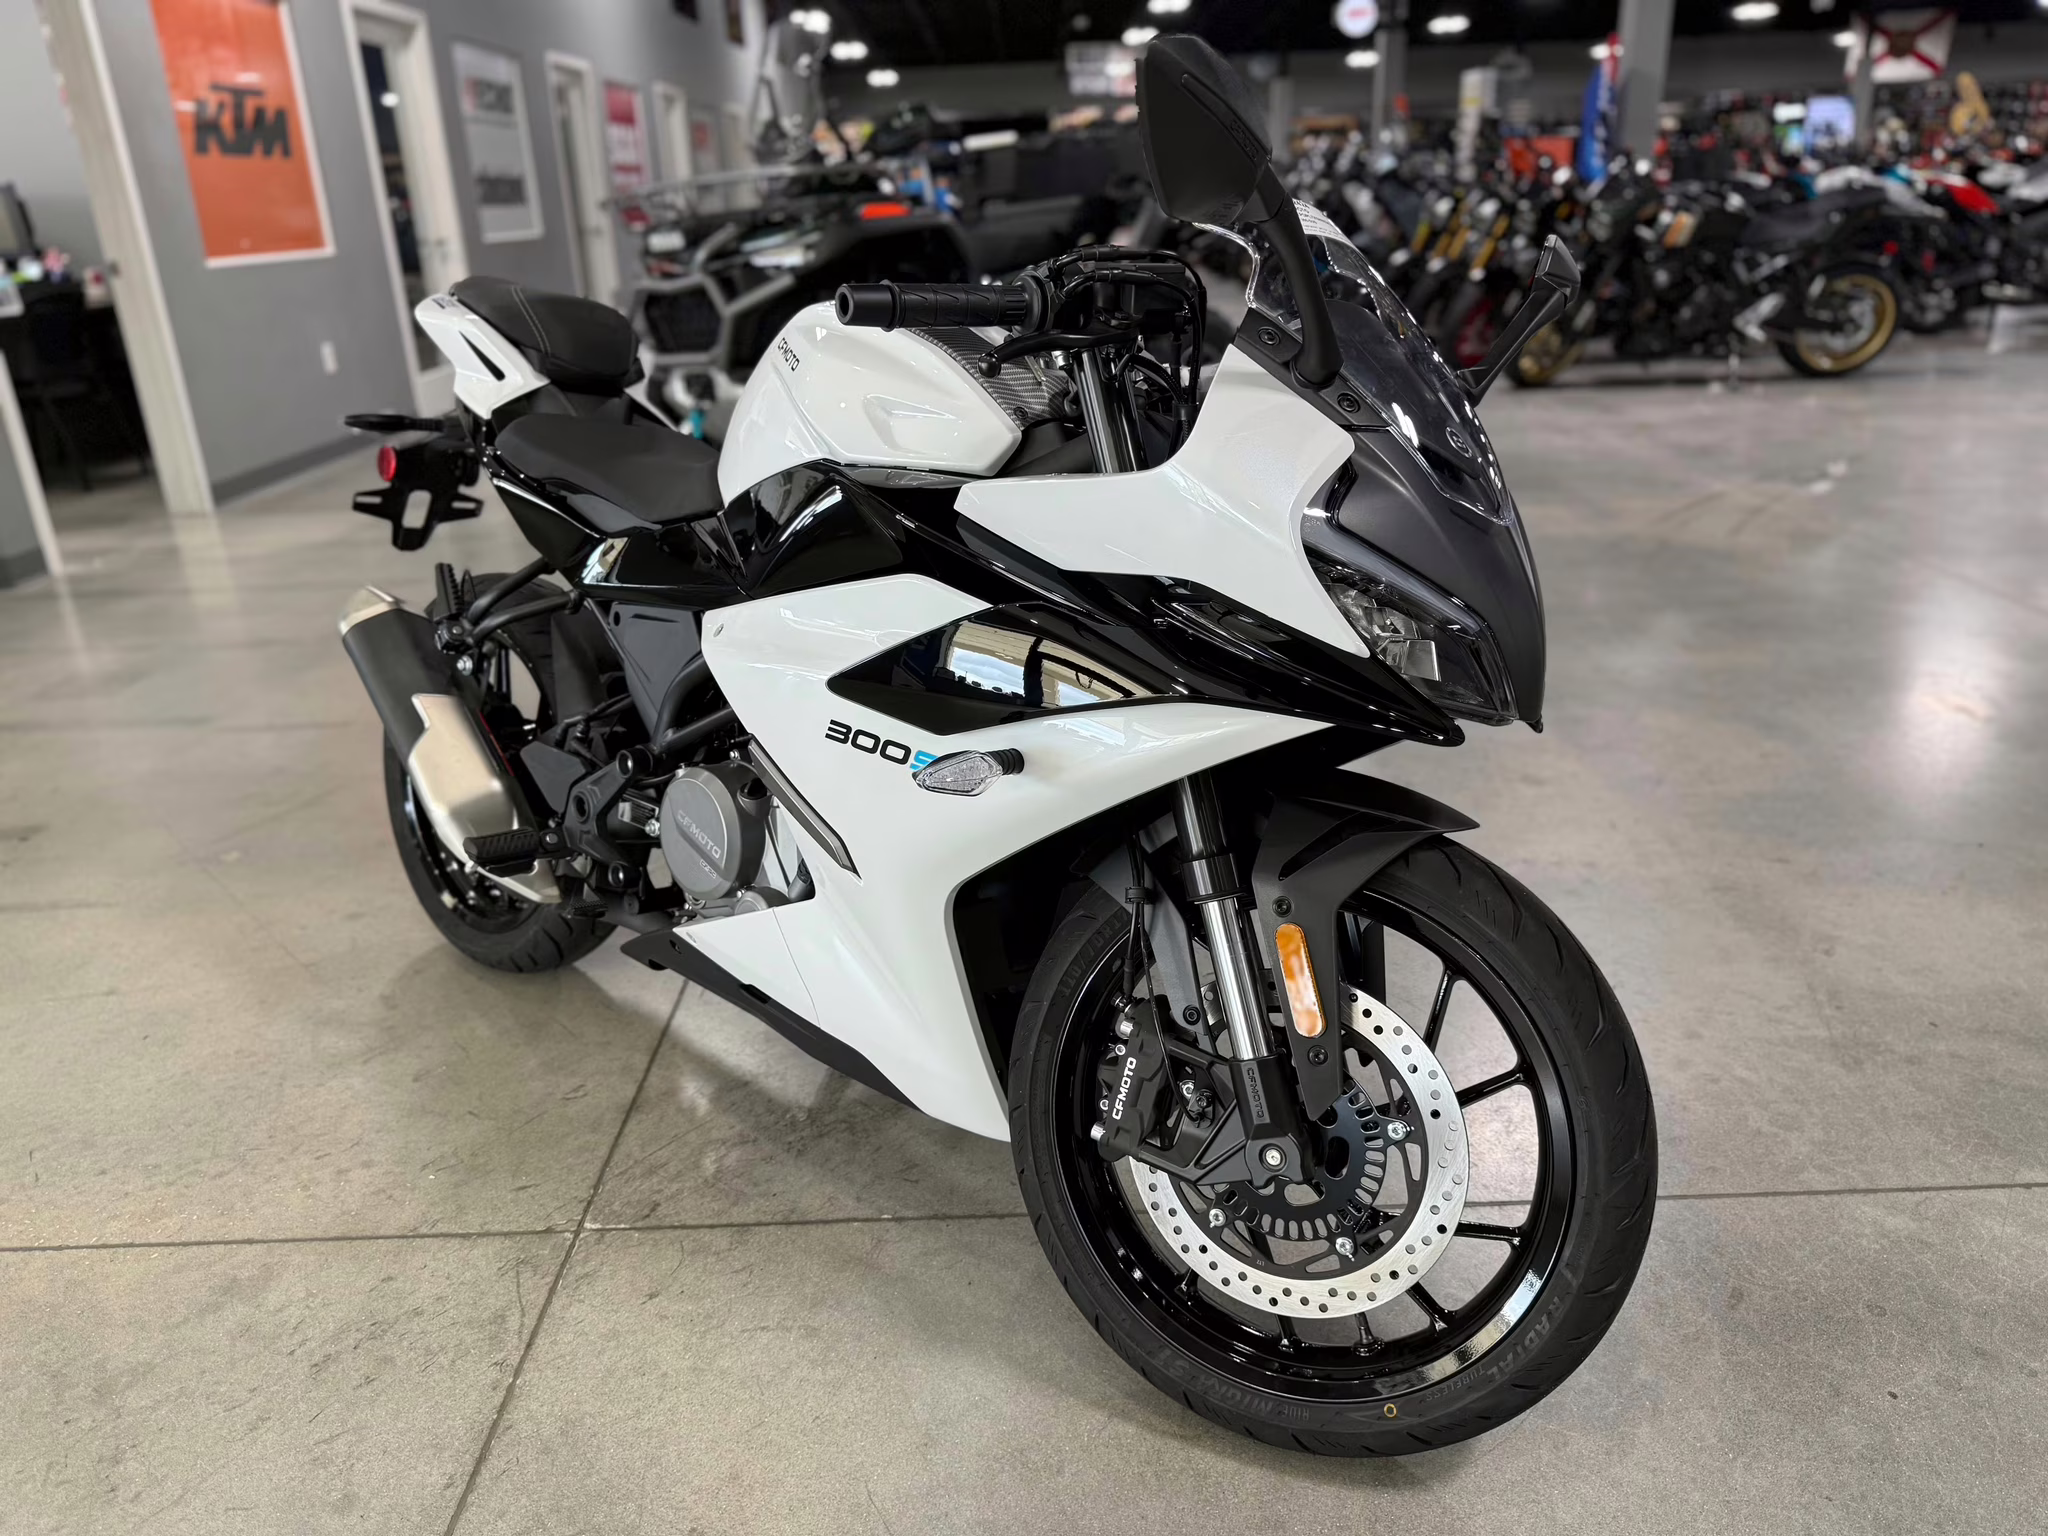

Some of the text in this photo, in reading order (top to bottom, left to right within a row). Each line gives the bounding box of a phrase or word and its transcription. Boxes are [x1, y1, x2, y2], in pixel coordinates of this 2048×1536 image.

[195, 83, 292, 158] KTM
[777, 337, 800, 372] CFMOTO
[677, 810, 721, 859] CFMOTO
[1112, 1056, 1137, 1121] CFMOTO
[1246, 1067, 1265, 1119] CFMOTO
[1487, 1297, 1566, 1381] RADIAL
[1426, 1364, 1489, 1401] TUBELESS
[1281, 1404, 1310, 1421] RIDE
